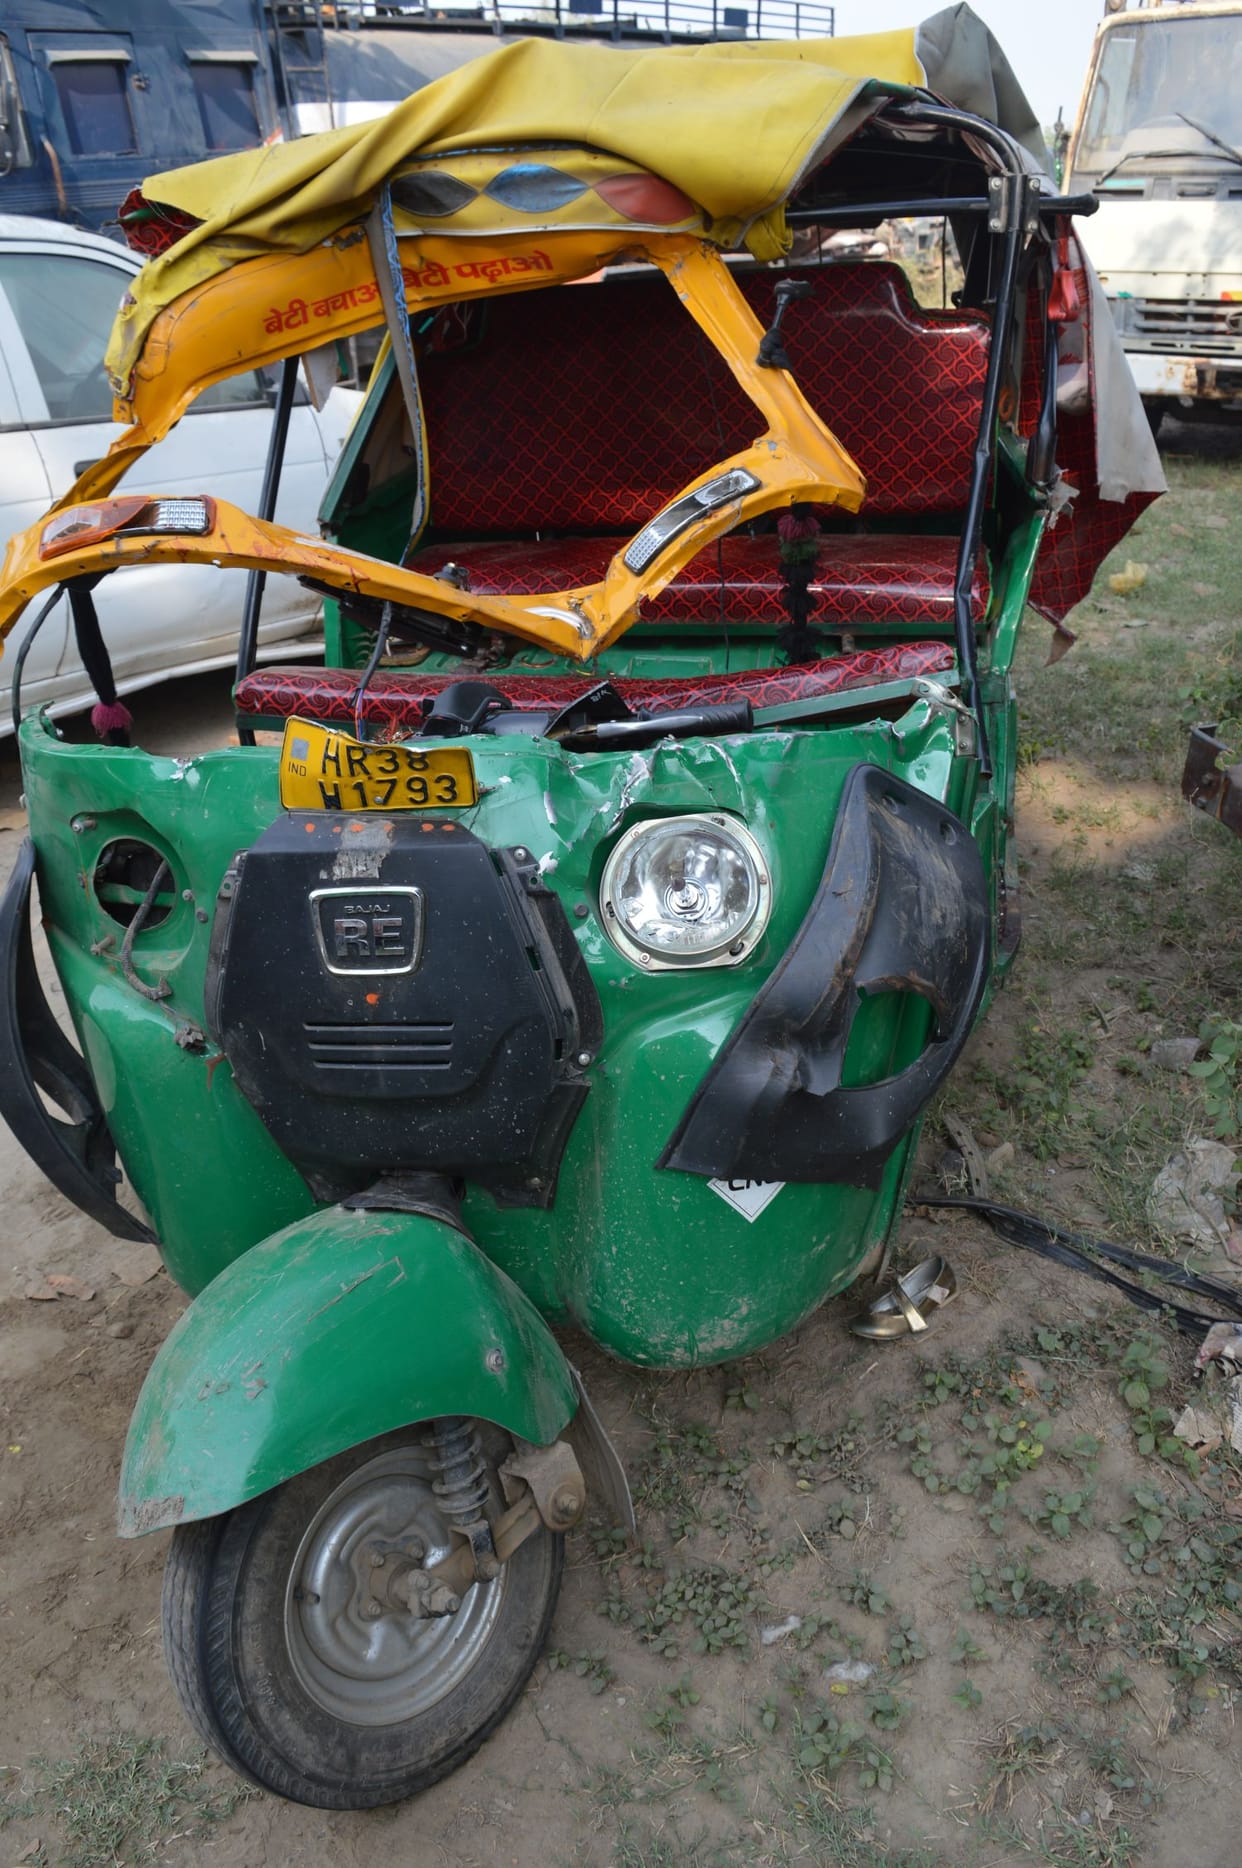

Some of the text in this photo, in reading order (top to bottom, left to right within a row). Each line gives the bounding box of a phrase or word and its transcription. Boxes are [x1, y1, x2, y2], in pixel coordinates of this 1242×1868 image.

[264, 298, 309, 334] बेटी
[288, 761, 307, 777] IND
[321, 737, 430, 777] HR38
[343, 904, 391, 914] BAJAJ
[334, 917, 405, 957] RE
